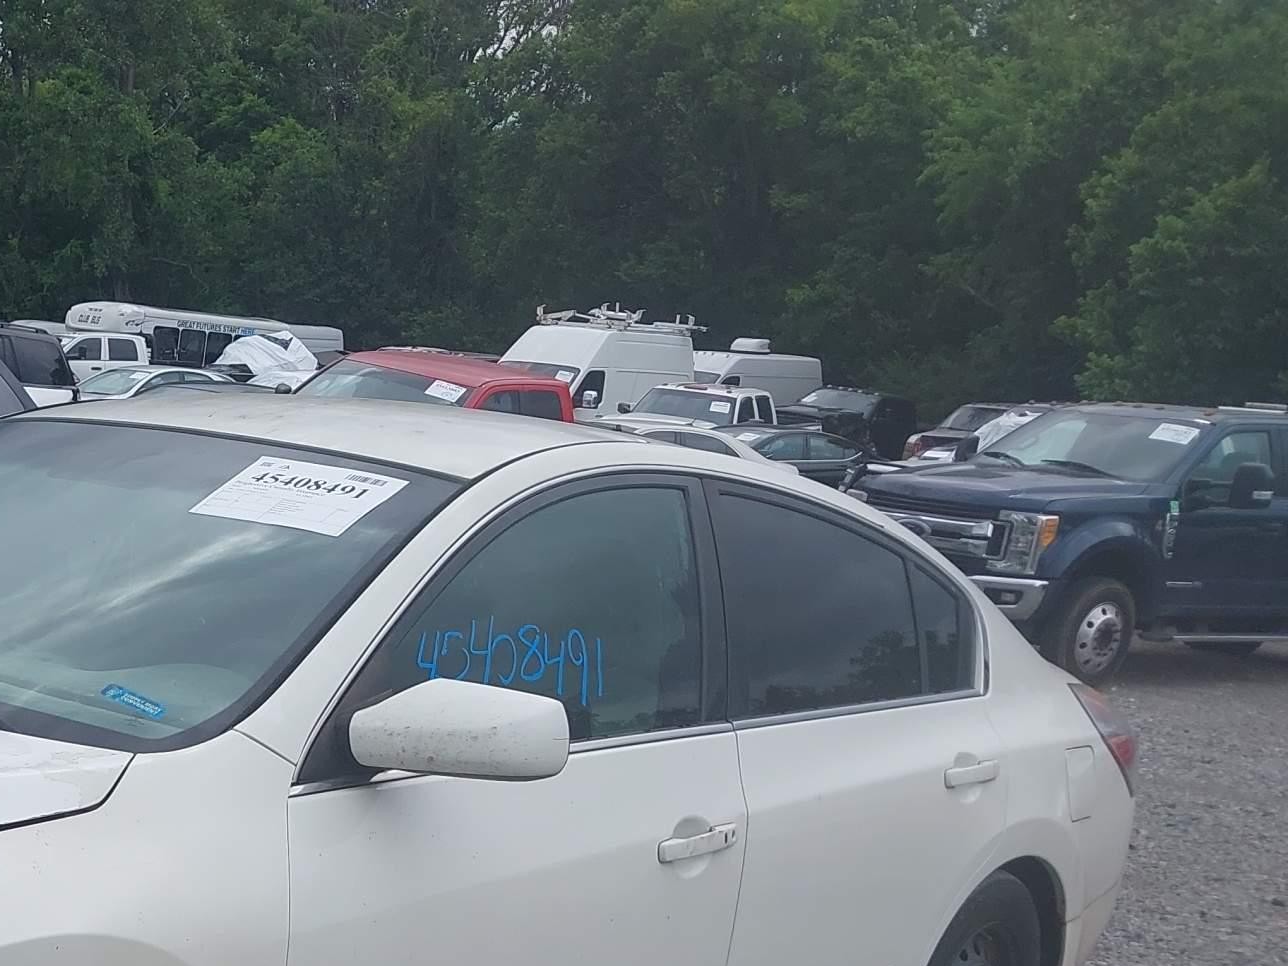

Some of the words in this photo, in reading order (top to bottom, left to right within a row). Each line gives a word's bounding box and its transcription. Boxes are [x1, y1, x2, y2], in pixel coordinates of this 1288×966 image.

[177, 320, 195, 329] GREAT
[196, 321, 221, 331] FUTURES
[223, 325, 240, 333] START
[251, 472, 370, 499] 45408491
